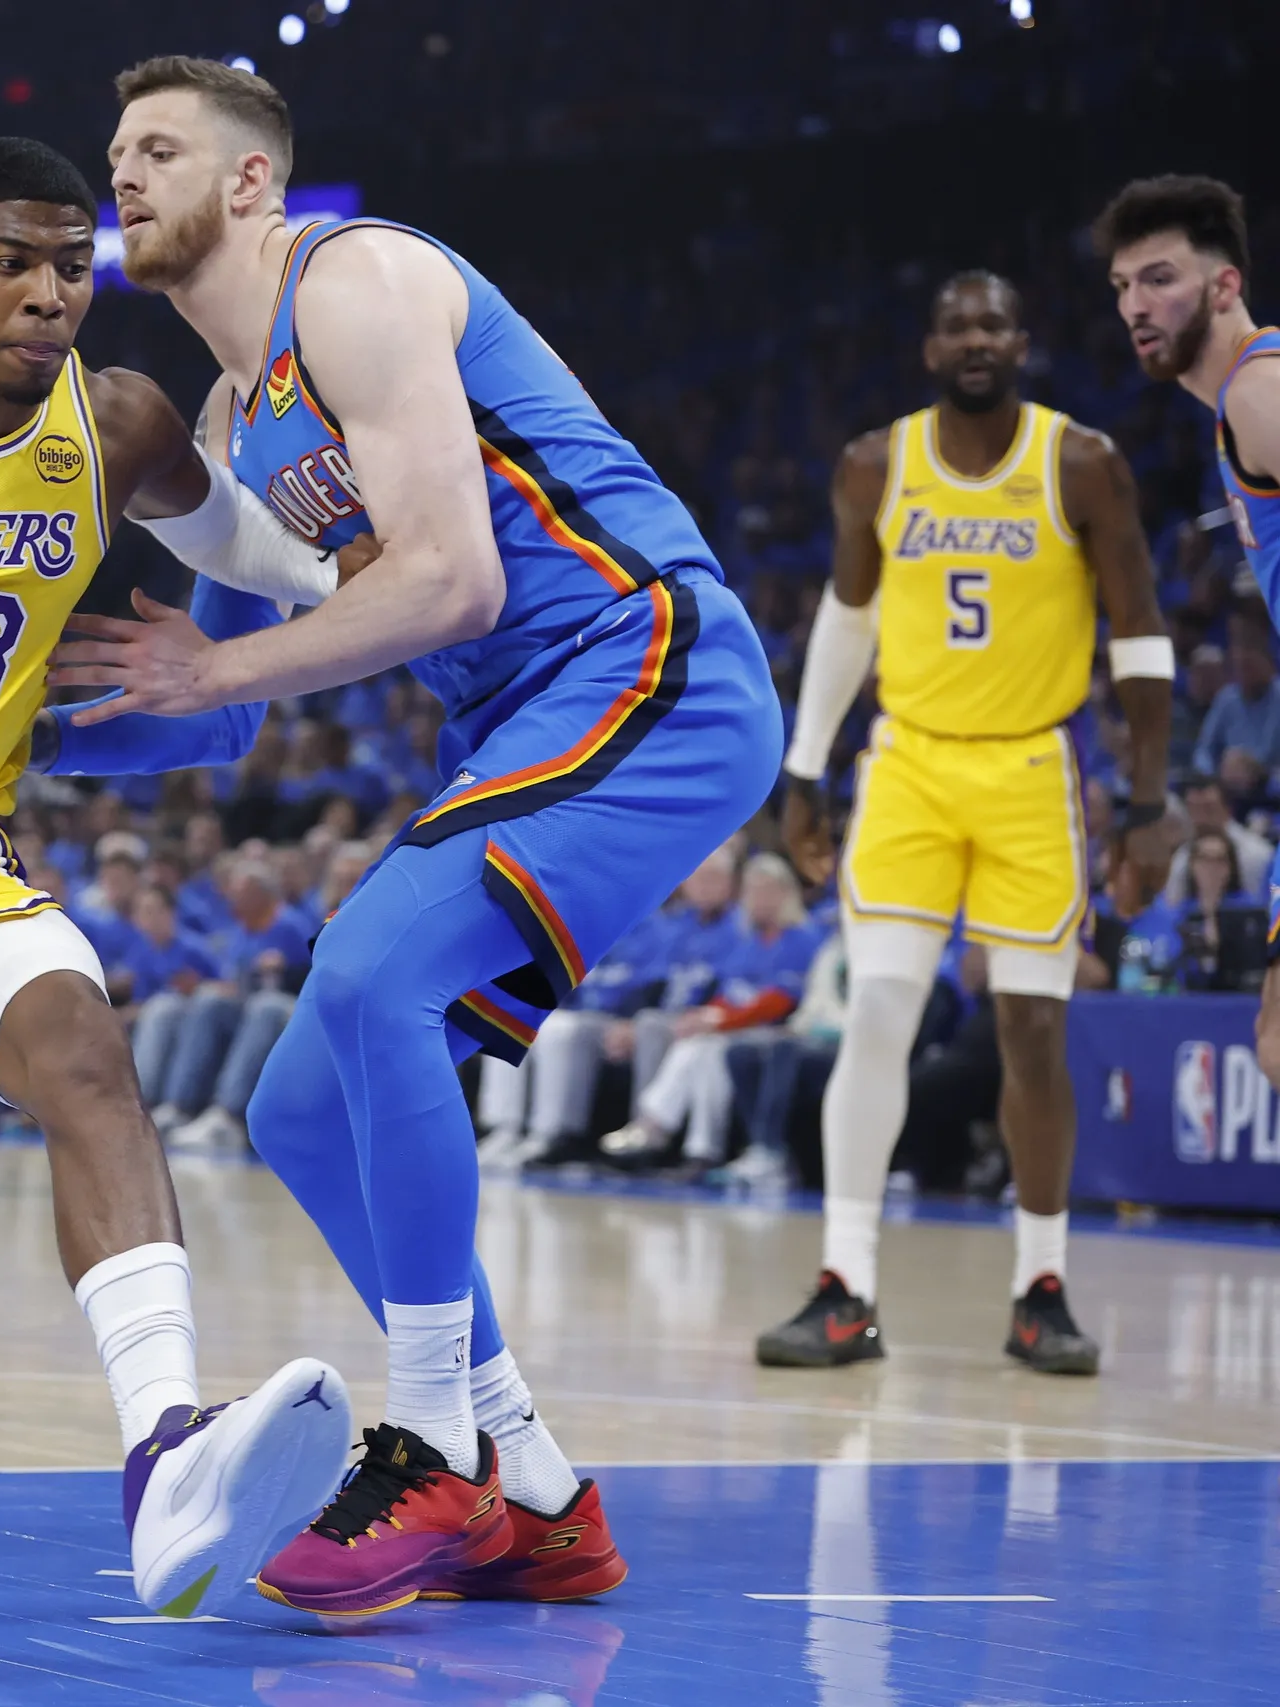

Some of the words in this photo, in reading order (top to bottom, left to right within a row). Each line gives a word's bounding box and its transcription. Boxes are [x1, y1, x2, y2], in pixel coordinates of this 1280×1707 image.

[38, 447, 81, 470] bibigo
[895, 508, 1038, 562] LAKERS
[946, 567, 993, 650] 5
